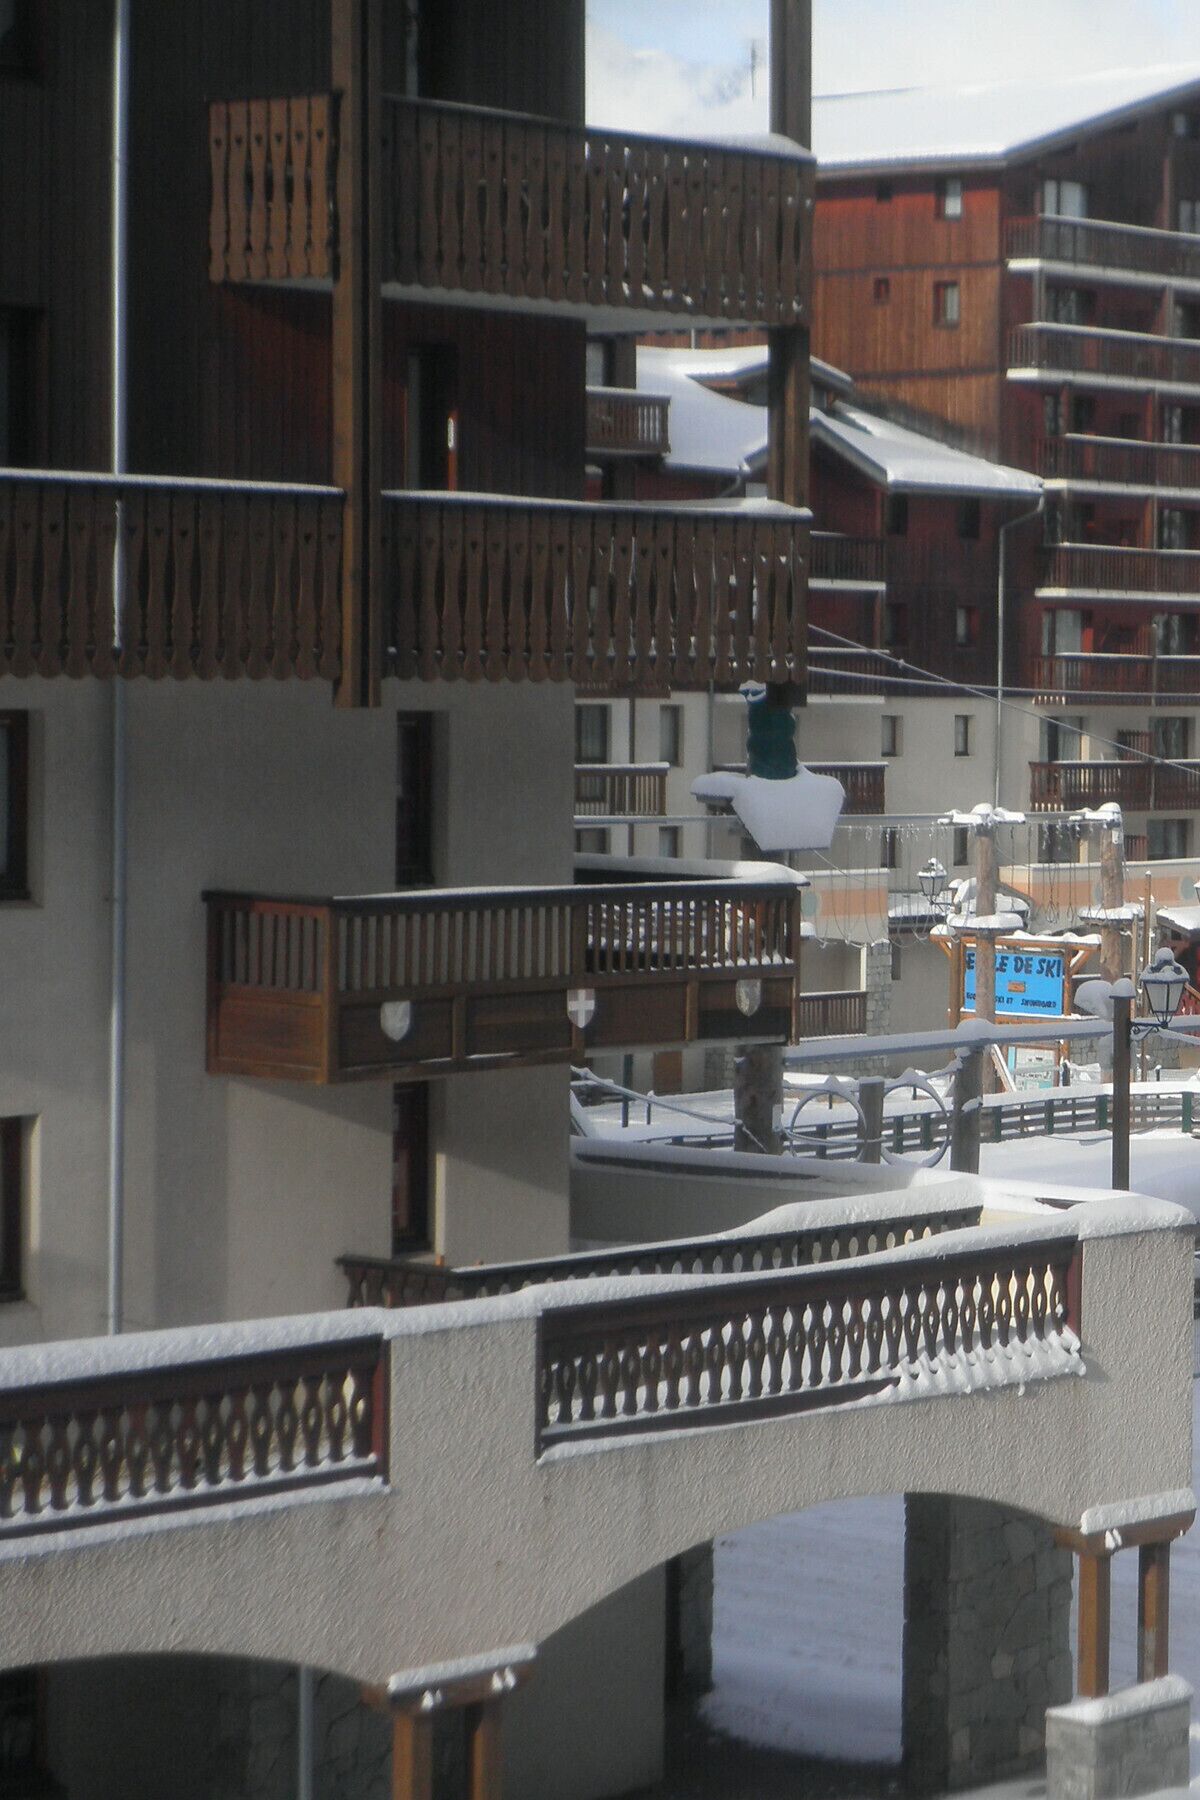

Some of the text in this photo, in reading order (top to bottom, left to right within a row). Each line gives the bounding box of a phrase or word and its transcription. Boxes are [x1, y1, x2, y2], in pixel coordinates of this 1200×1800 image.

[966, 952, 1062, 978] ELE DE SKI
